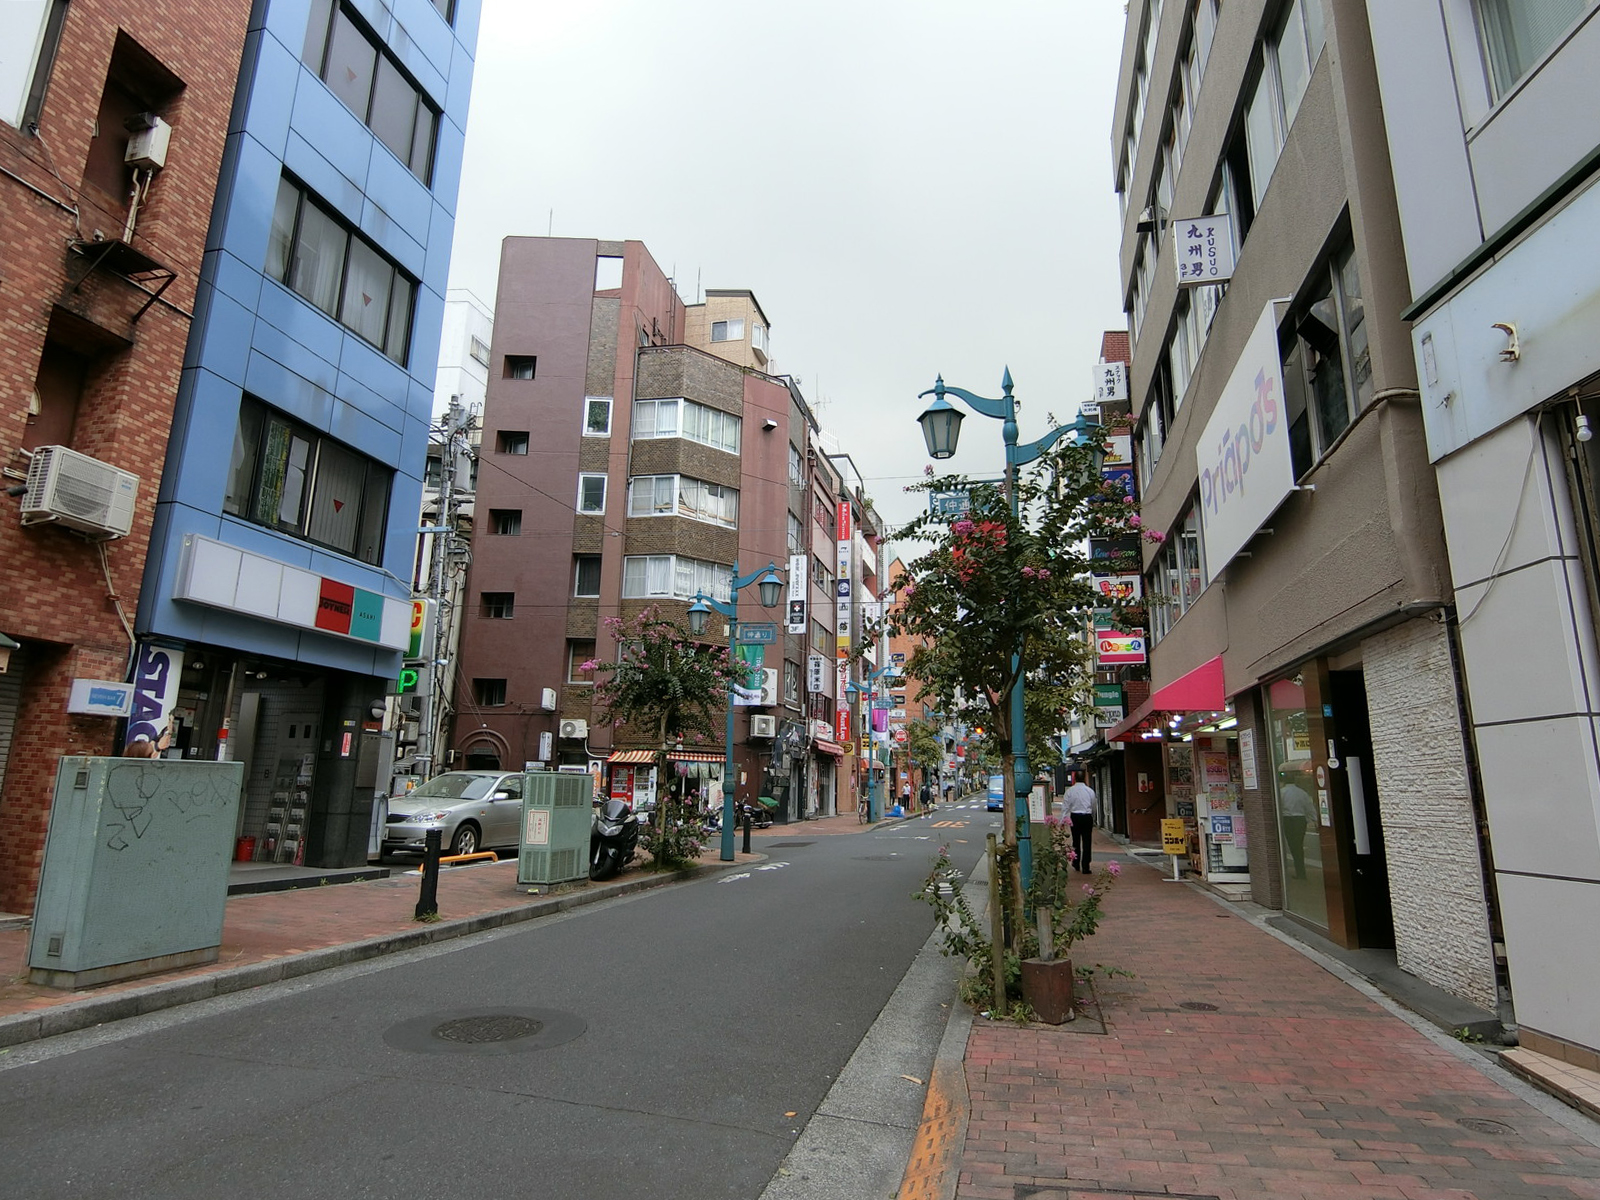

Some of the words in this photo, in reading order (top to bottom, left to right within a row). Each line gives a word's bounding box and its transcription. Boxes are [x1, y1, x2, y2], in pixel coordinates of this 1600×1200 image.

[1187, 224, 1203, 277] 九州男
[1206, 227, 1218, 276] KUSUO
[1180, 263, 1188, 278] 3F
[1104, 368, 1115, 397] 九州男
[398, 670, 418, 693] P
